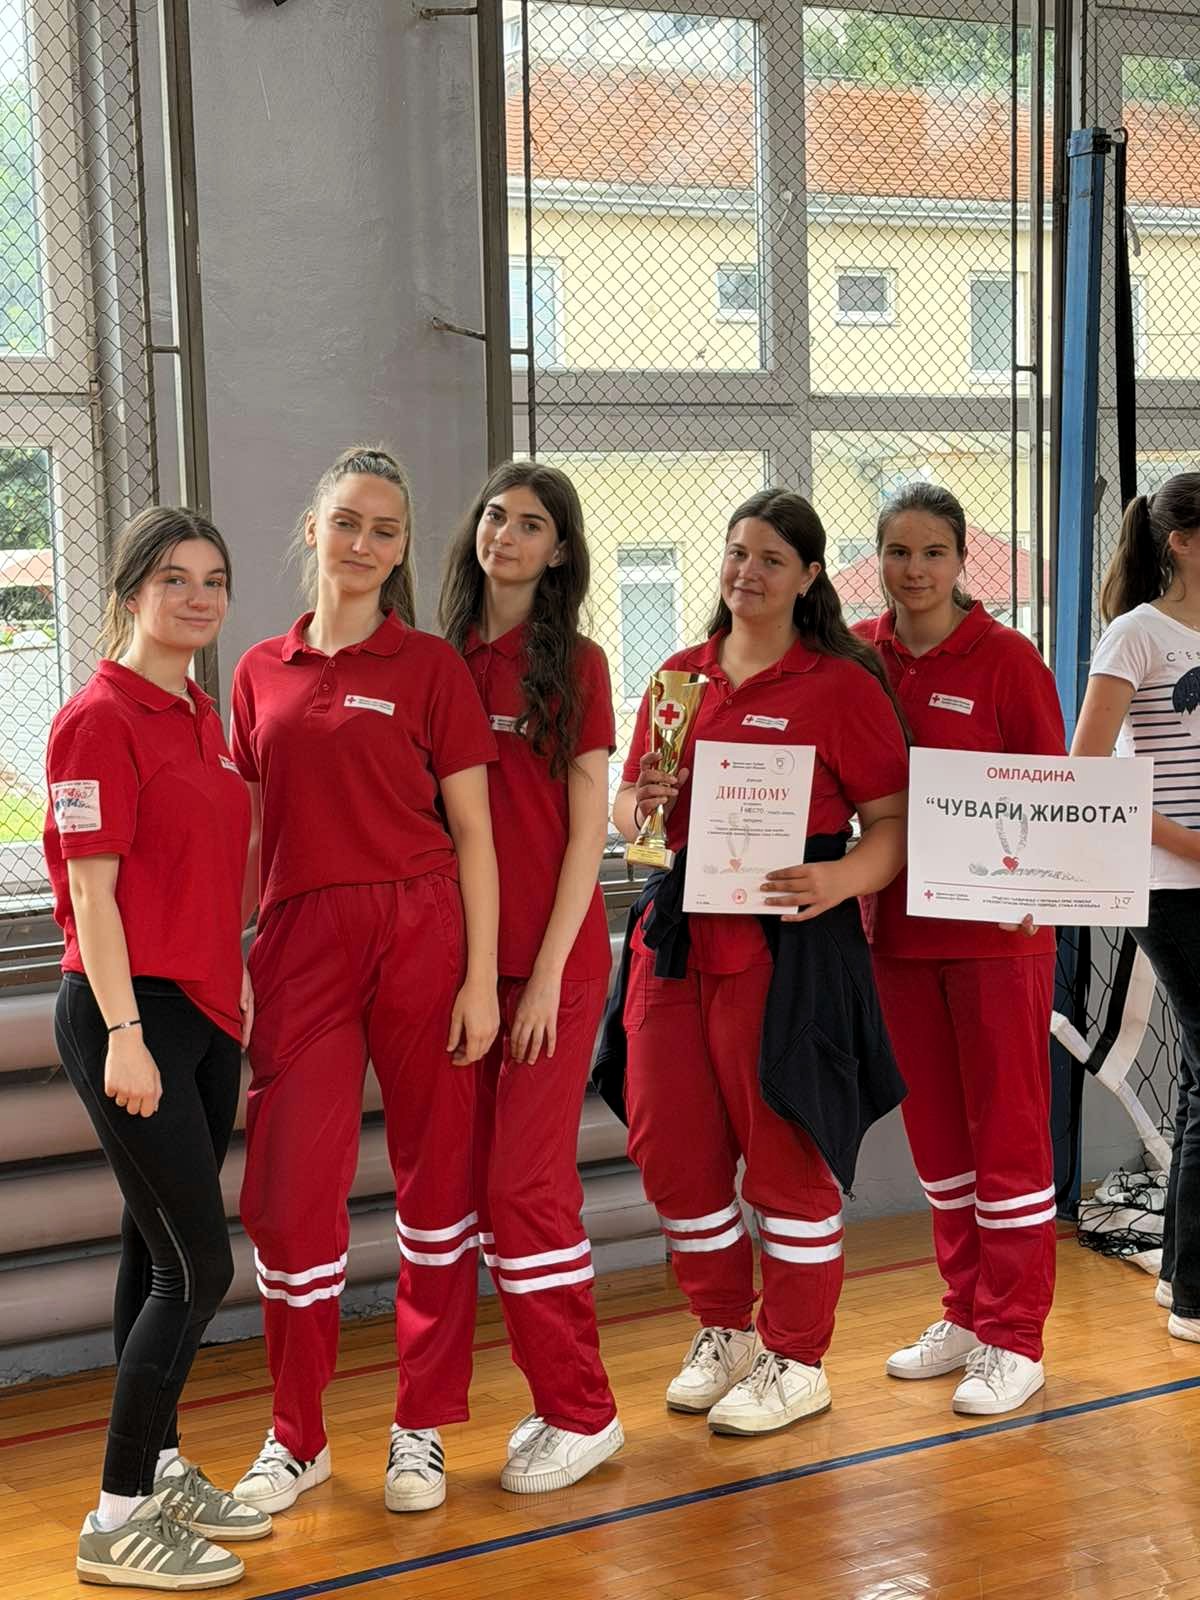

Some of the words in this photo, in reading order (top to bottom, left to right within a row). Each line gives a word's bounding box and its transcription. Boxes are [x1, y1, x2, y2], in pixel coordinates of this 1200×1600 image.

[987, 767, 1075, 784] ОМЛАДИНА
[715, 785, 790, 801] ДИПЛОМУ
[926, 797, 1023, 820] “ЧУВАРИ
[1029, 803, 1138, 824] ЖИВОТА”
